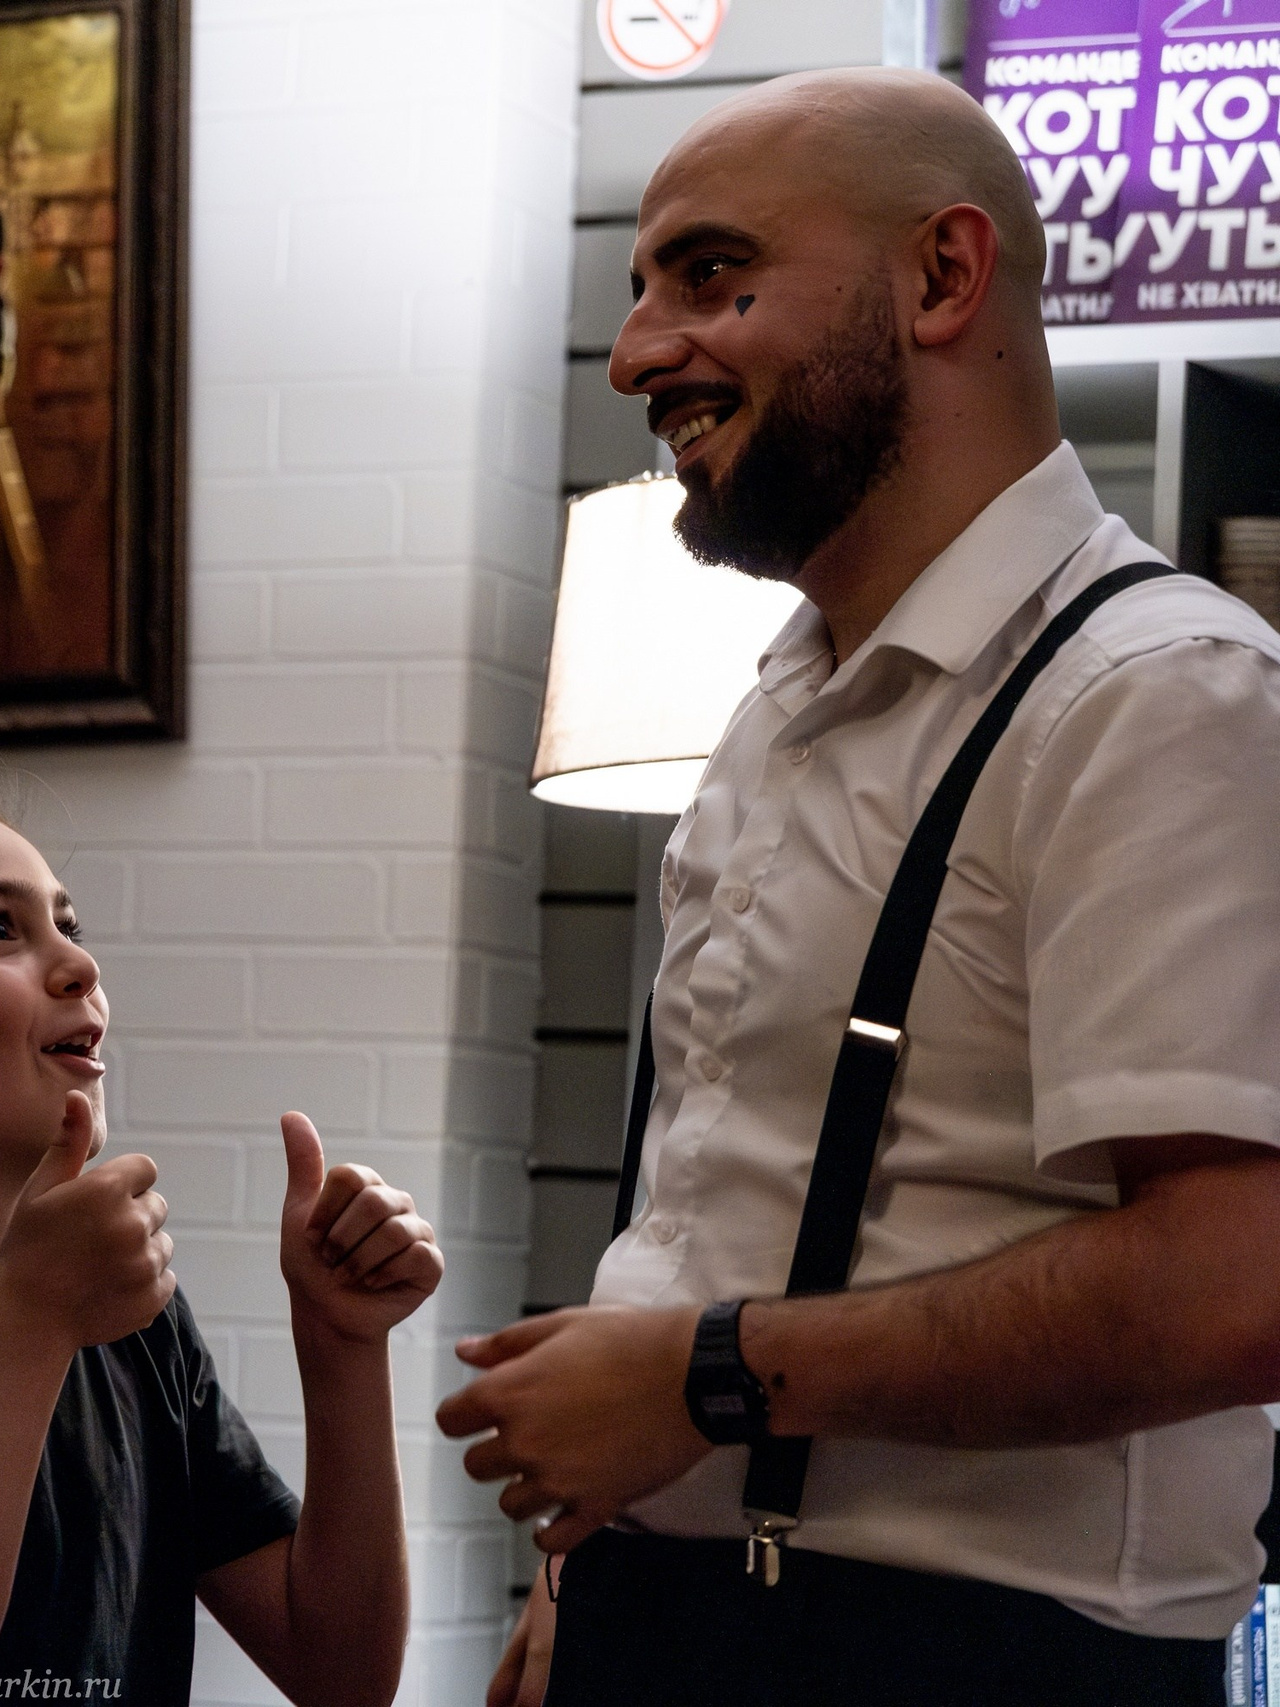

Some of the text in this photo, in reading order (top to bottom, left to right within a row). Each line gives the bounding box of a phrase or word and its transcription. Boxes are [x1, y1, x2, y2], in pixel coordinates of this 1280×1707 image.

[984, 50, 1139, 87] КОМАНДЕ
[1160, 38, 1280, 74] КОМАН
[983, 87, 1137, 156] КОТ
[1020, 153, 1131, 219] УУ
[1042, 221, 1114, 285] ТЬ
[1137, 279, 1280, 310] НЕ ХВАТИ
